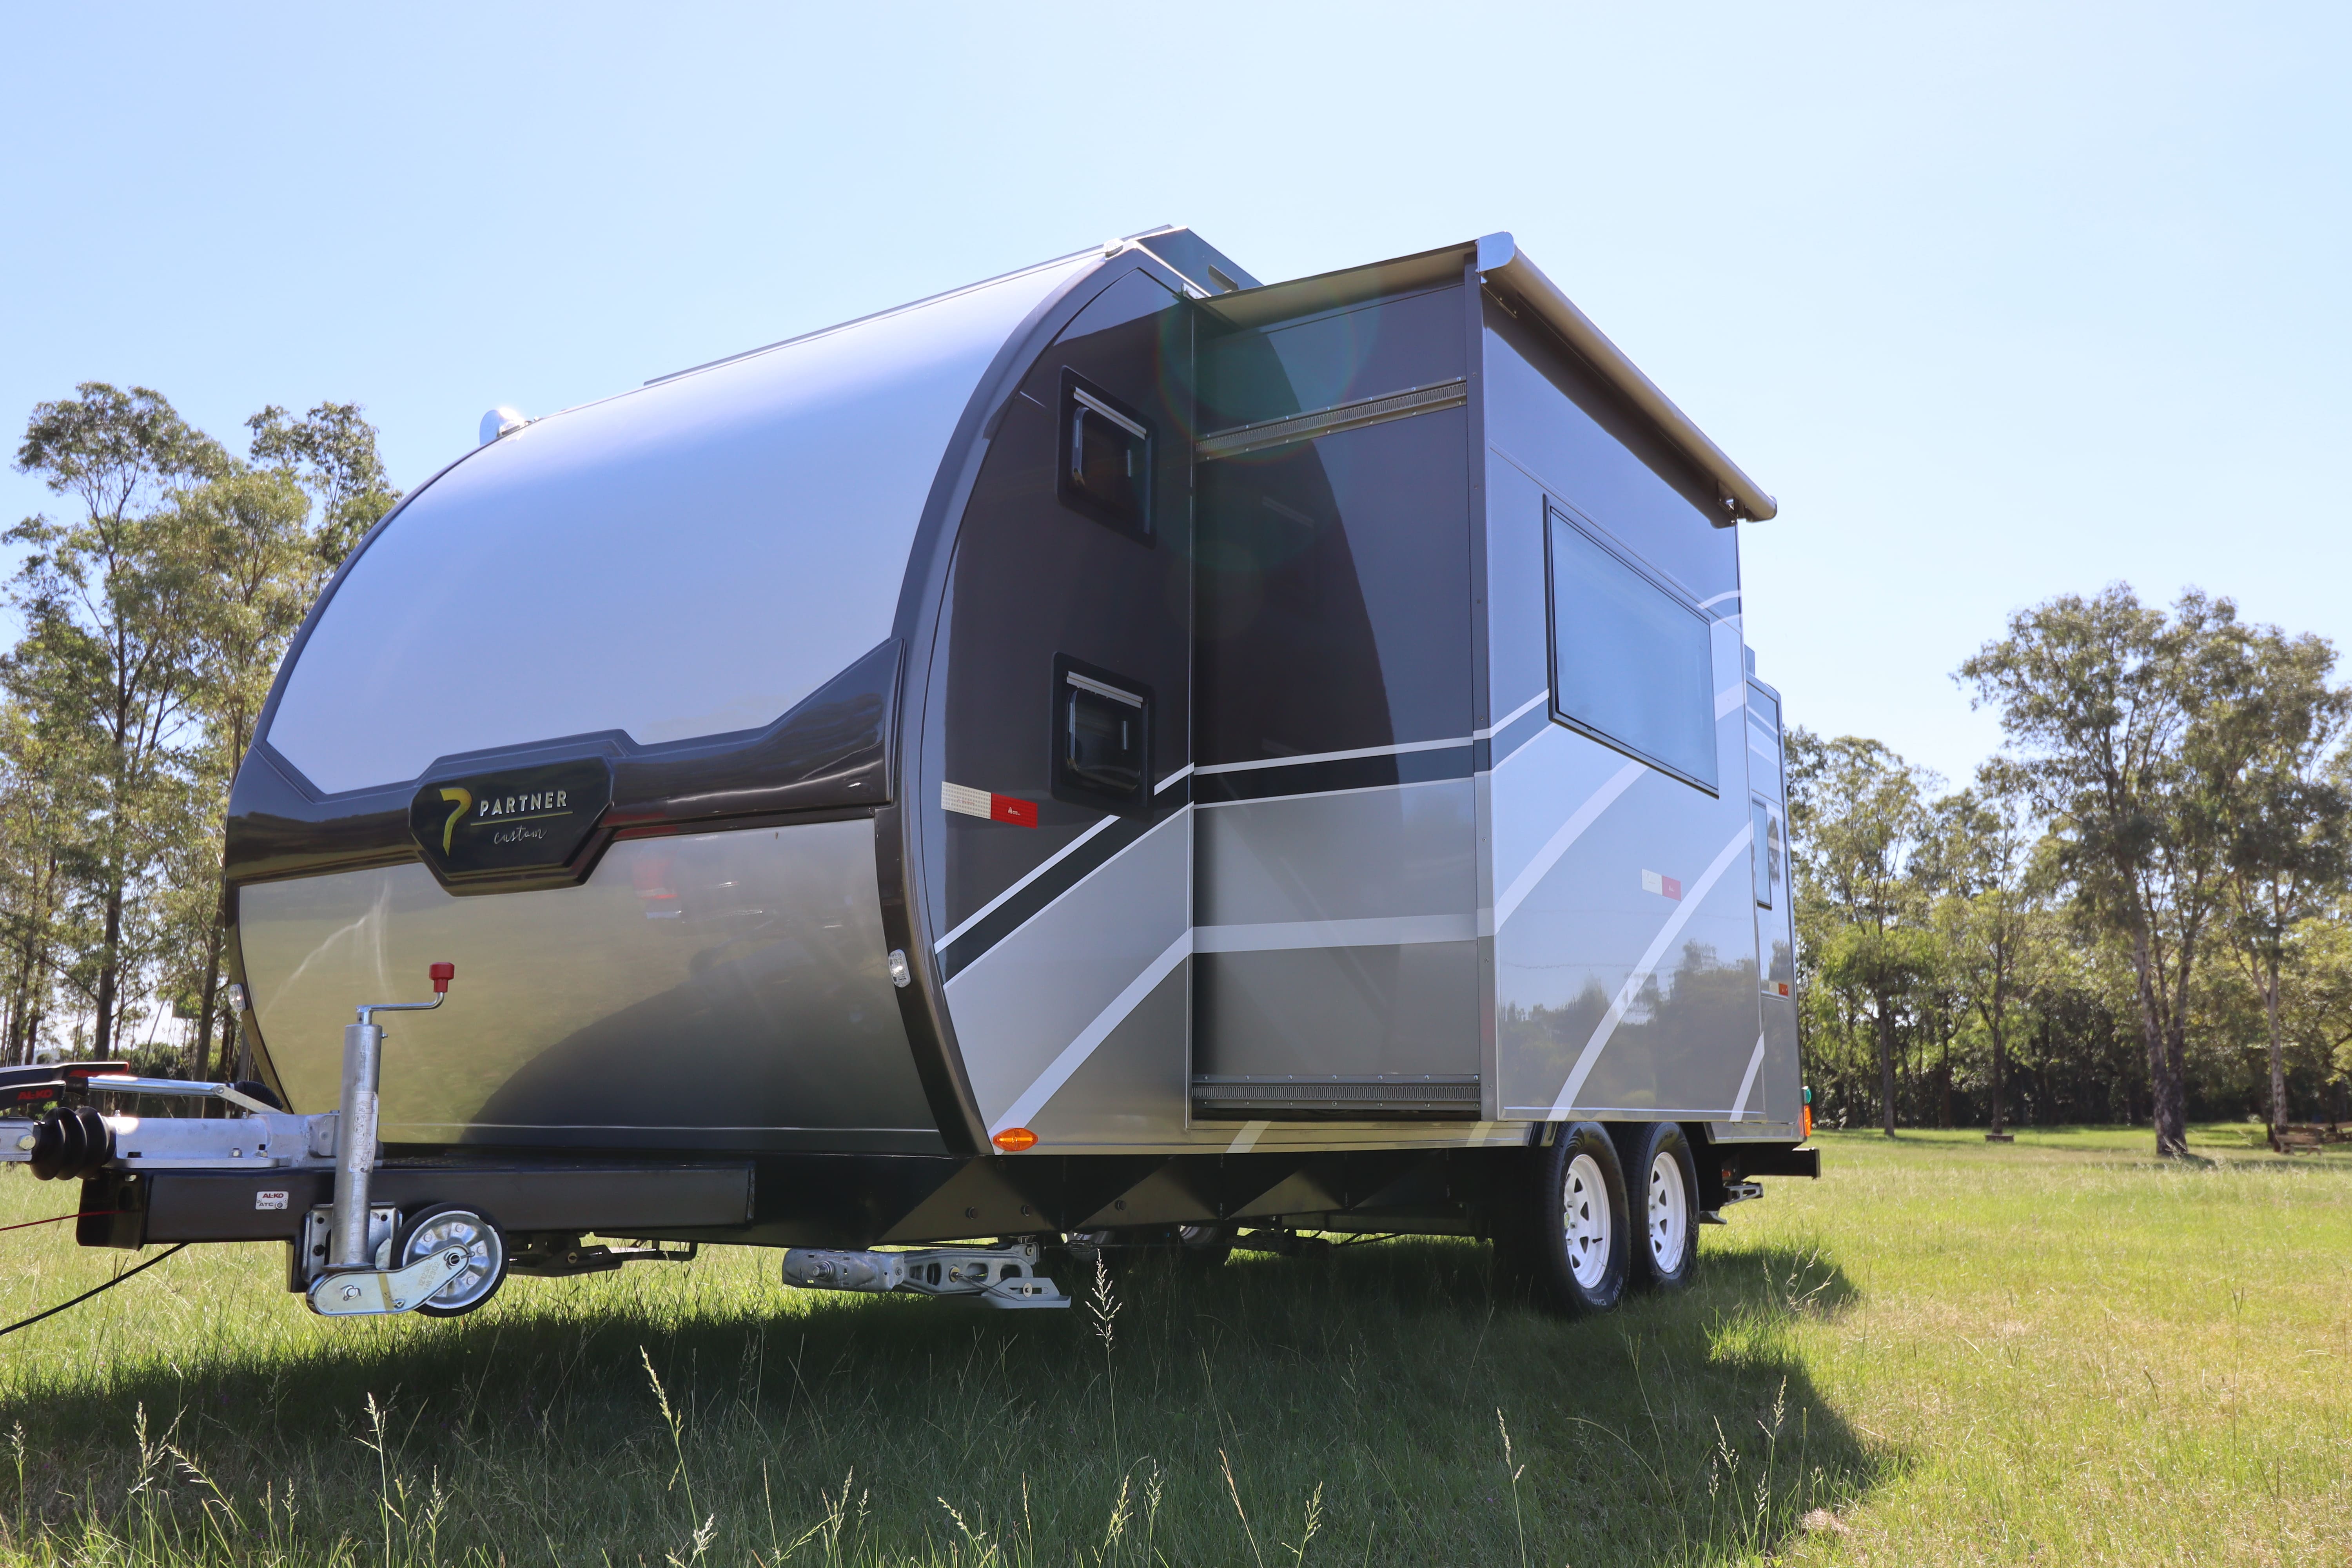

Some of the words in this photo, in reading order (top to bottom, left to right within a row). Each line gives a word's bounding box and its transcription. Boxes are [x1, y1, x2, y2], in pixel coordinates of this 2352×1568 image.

[479, 790, 568, 817] PARTNER
[494, 825, 548, 844] custom
[17, 1089, 54, 1100] AL-KO
